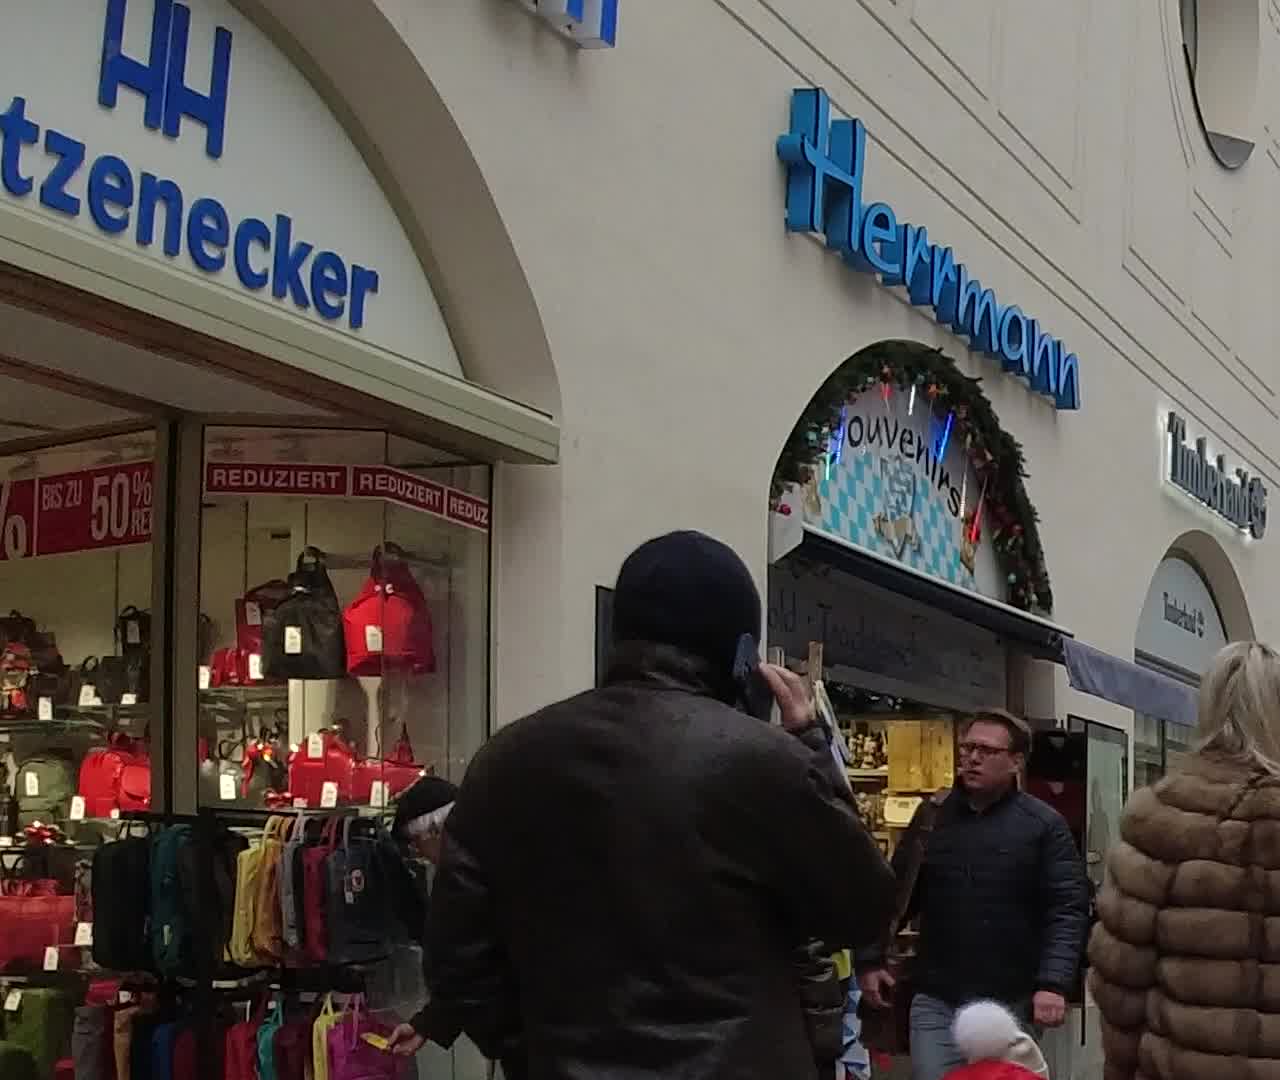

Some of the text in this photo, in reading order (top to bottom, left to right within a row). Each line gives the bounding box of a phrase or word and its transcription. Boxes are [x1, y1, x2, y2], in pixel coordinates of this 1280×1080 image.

[776, 87, 1081, 411] Herrmann
[212, 469, 341, 488] REDUZIERT
[848, 414, 963, 518] ouvenirs
[42, 482, 63, 511] BIS
[65, 479, 83, 508] ZU
[359, 473, 441, 508] REDUZIERT
